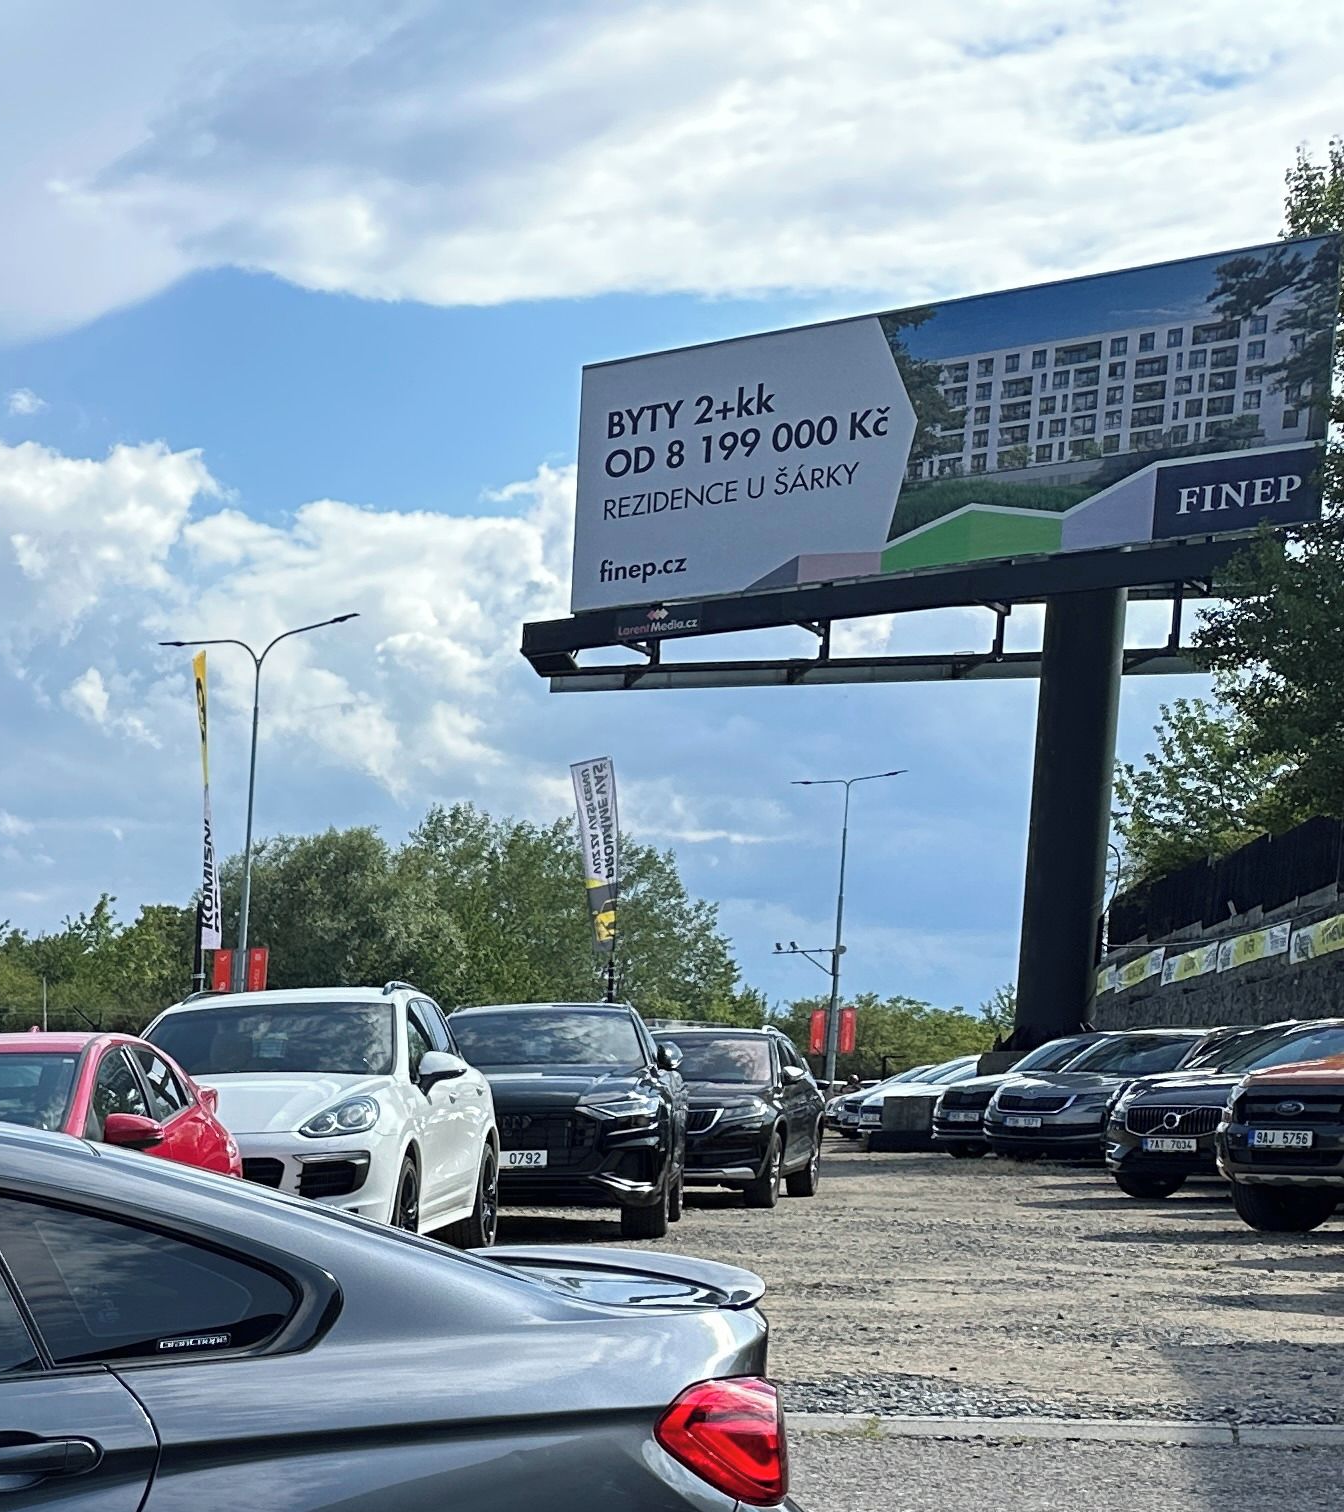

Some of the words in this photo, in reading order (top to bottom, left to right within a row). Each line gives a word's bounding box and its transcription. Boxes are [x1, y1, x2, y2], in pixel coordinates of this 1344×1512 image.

[607, 399, 685, 439] BYTY
[694, 383, 776, 425] 2+kk
[605, 445, 655, 478] OD
[666, 439, 685, 469] 8
[702, 428, 761, 464] 199
[772, 416, 838, 452] 000
[849, 406, 891, 440] Kč
[603, 480, 739, 520] REZIDENCE
[747, 476, 765, 499] U
[774, 461, 860, 496] ŠÁRKY
[1176, 475, 1302, 515] FINEP
[599, 557, 688, 584] finep.cz
[509, 1152, 541, 1165] 0792
[1256, 1131, 1275, 1145] 9AJ
[1283, 1131, 1309, 1146] 5756
